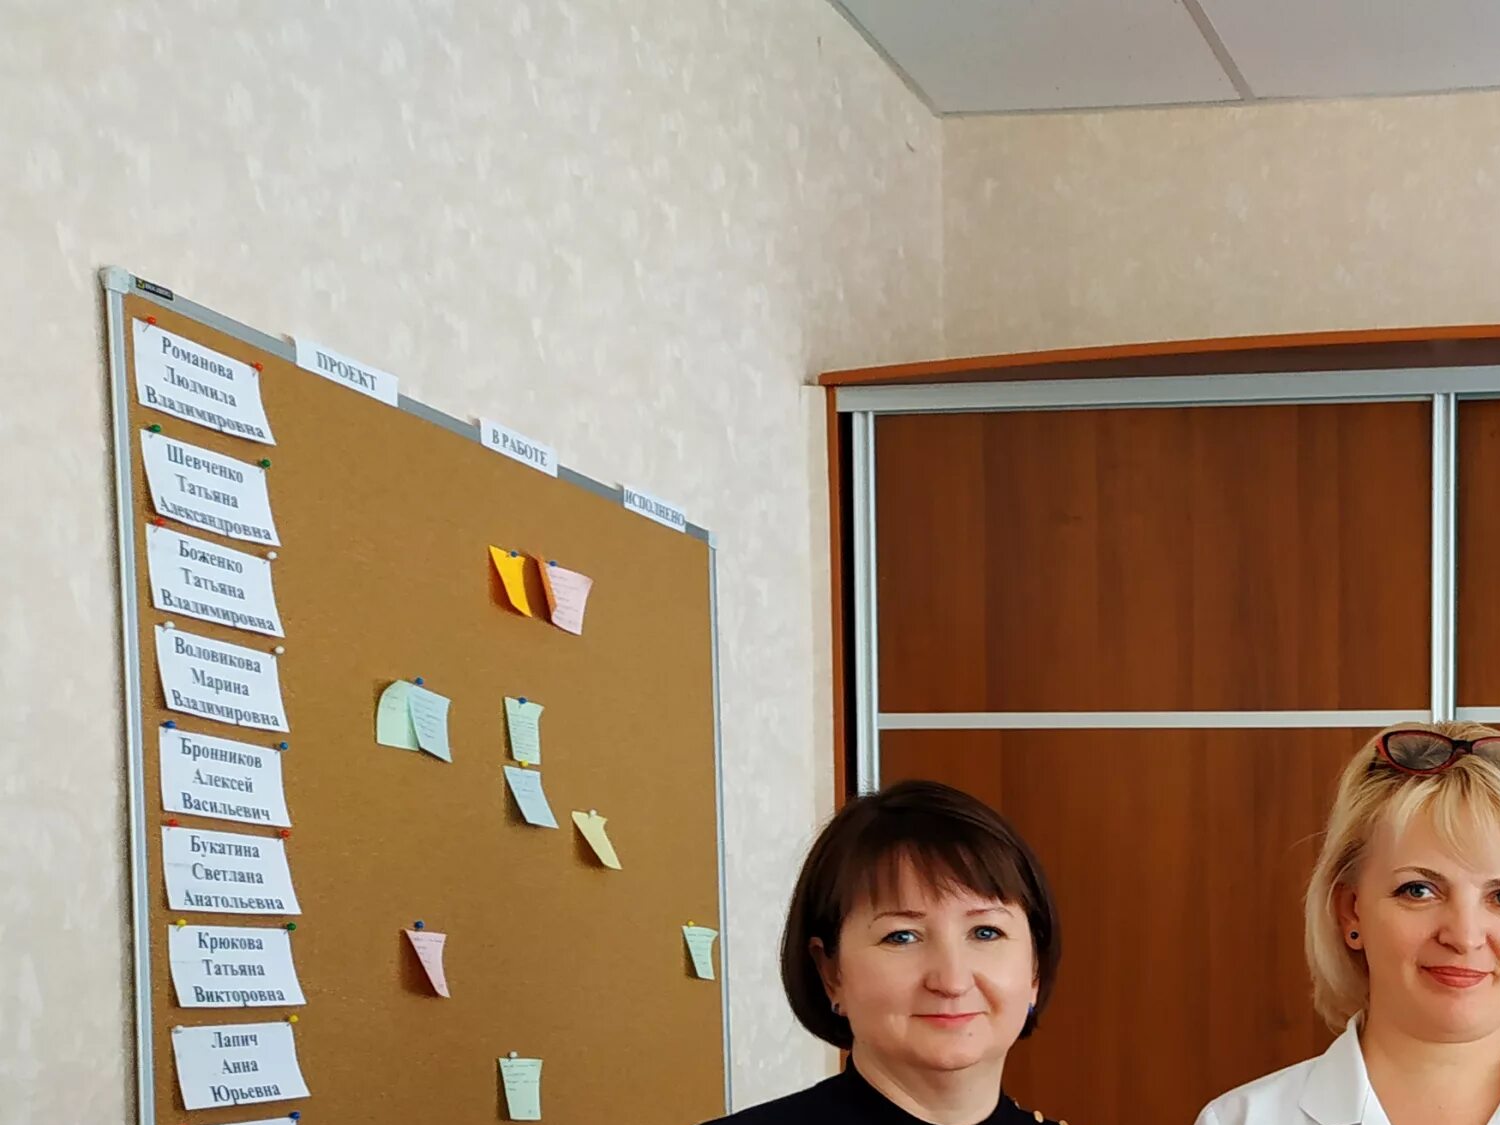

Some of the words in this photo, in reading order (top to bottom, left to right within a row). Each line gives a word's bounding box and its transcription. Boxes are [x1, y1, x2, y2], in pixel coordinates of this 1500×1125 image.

[161, 337, 235, 382] Романова
[315, 351, 377, 392] ПРОЕКТ
[163, 365, 237, 408] Людмила
[144, 385, 266, 439] Владимировна
[166, 443, 244, 484] Шевченко
[492, 428, 500, 446] В
[501, 431, 548, 467] РАБОТЕ
[174, 473, 239, 509] Татьяна
[625, 489, 685, 526] ИСПОЛНЕНО
[159, 495, 272, 541] Александровна
[178, 539, 244, 575] Боженко
[181, 567, 245, 600] Татьяна
[160, 588, 276, 632] Владимировна
[174, 636, 261, 673] Воловикова
[190, 667, 250, 696] Марина
[171, 689, 280, 727] Владимировна
[180, 737, 262, 768] Бронников
[192, 769, 253, 793] Алексей
[181, 792, 271, 821] Васильевич
[190, 834, 260, 858] Букатина
[191, 862, 264, 884] Светлана
[183, 890, 285, 910] Анатольевна
[198, 931, 263, 953] Крюкова
[202, 959, 265, 977] Татьяна
[193, 985, 285, 1008] Викторовна
[211, 1031, 259, 1049] Лапич
[221, 1058, 259, 1075] Анна
[209, 1083, 281, 1106] Юрьевна
